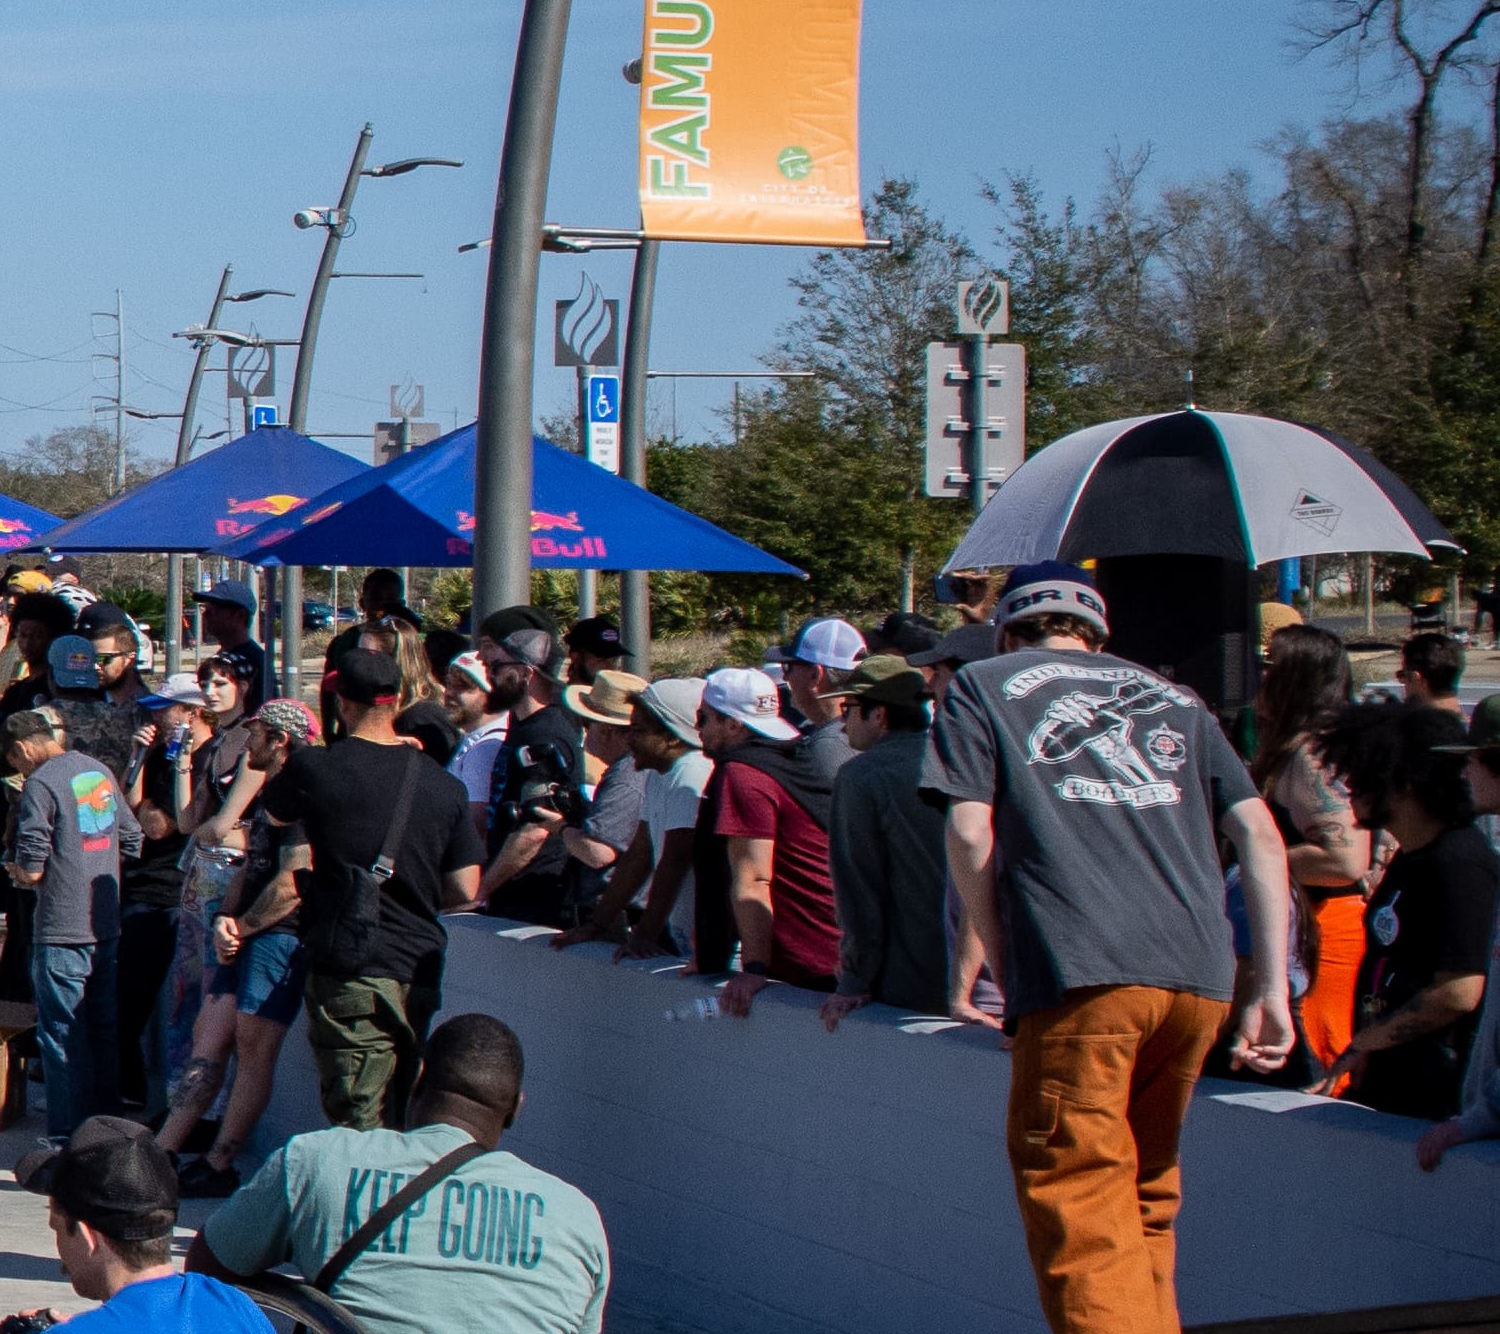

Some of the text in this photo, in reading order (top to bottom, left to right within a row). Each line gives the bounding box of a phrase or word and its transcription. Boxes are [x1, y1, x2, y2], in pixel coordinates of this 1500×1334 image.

[530, 537, 607, 558] Bull
[1009, 664, 1196, 705] INDEPENDE
[341, 1168, 545, 1271] KEEP GOING
